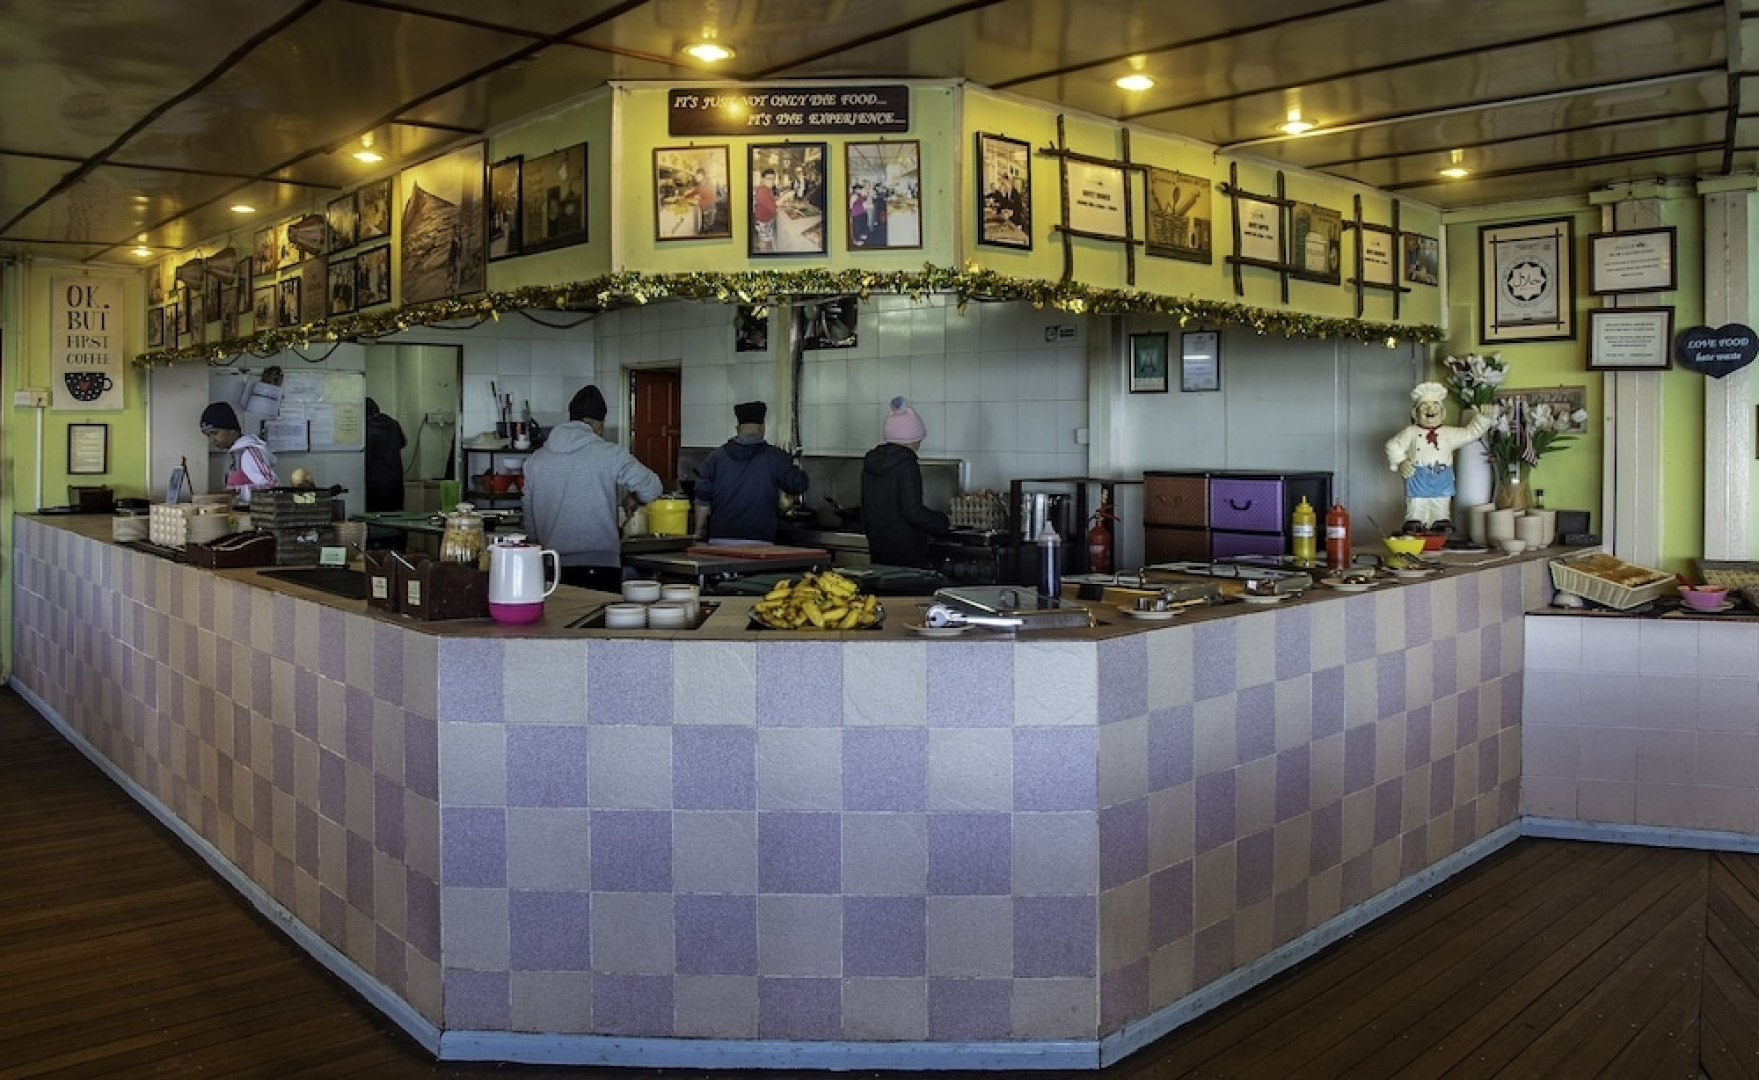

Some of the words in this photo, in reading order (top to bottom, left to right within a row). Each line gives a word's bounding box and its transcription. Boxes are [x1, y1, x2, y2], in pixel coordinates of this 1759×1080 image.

[674, 95, 699, 108] IT'S
[770, 94, 809, 107] ONLY
[809, 93, 837, 106] THE
[747, 112, 772, 127] IT'S
[775, 112, 804, 126] THE
[66, 284, 110, 309] OK.
[67, 310, 110, 331] BUT
[67, 335, 110, 349] FIRST
[1687, 339, 1717, 349] LOVE
[1718, 337, 1749, 348] FOOD
[66, 353, 111, 365] COFFEE
